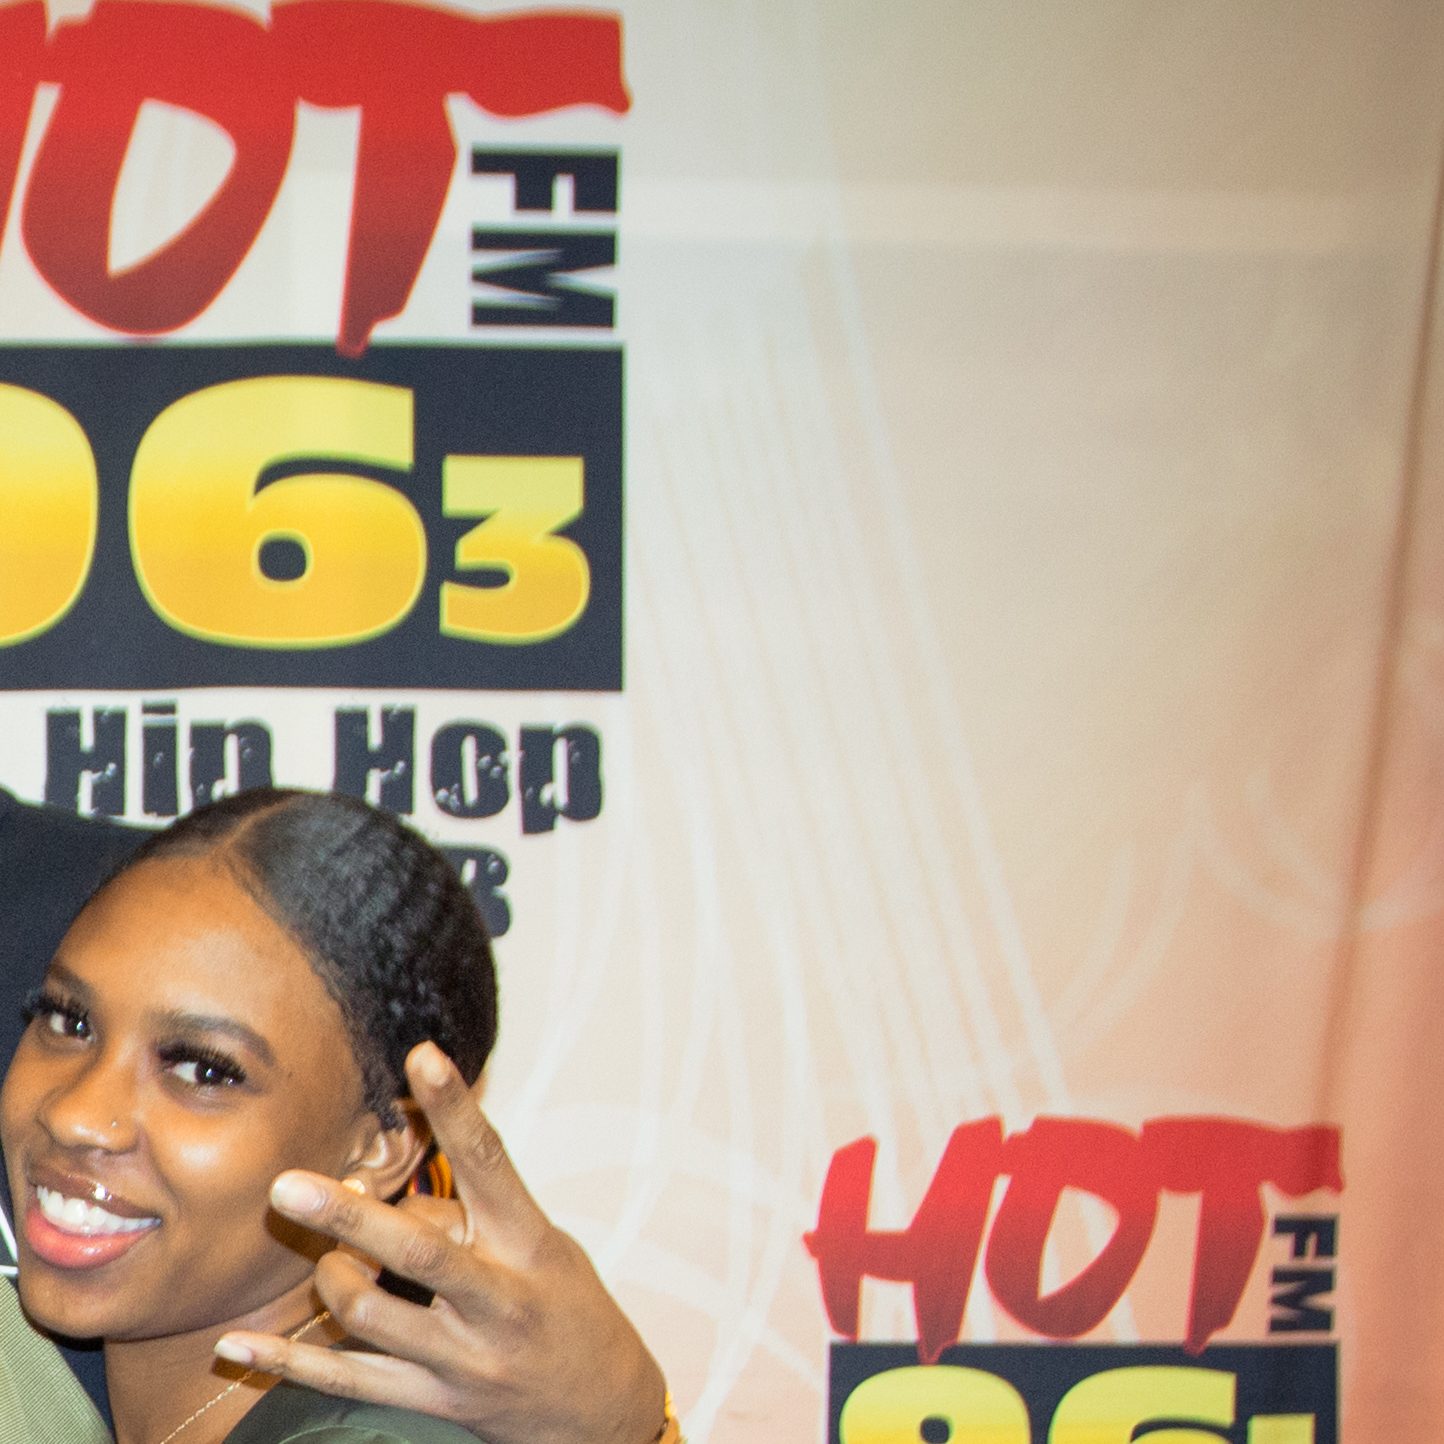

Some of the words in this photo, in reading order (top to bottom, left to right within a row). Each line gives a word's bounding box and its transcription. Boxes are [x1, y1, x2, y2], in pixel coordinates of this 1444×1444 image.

[470, 145, 622, 330] FM
[331, 703, 604, 835] Hop
[802, 1114, 1346, 1366] HOT
[1267, 1213, 1339, 1337] FM
